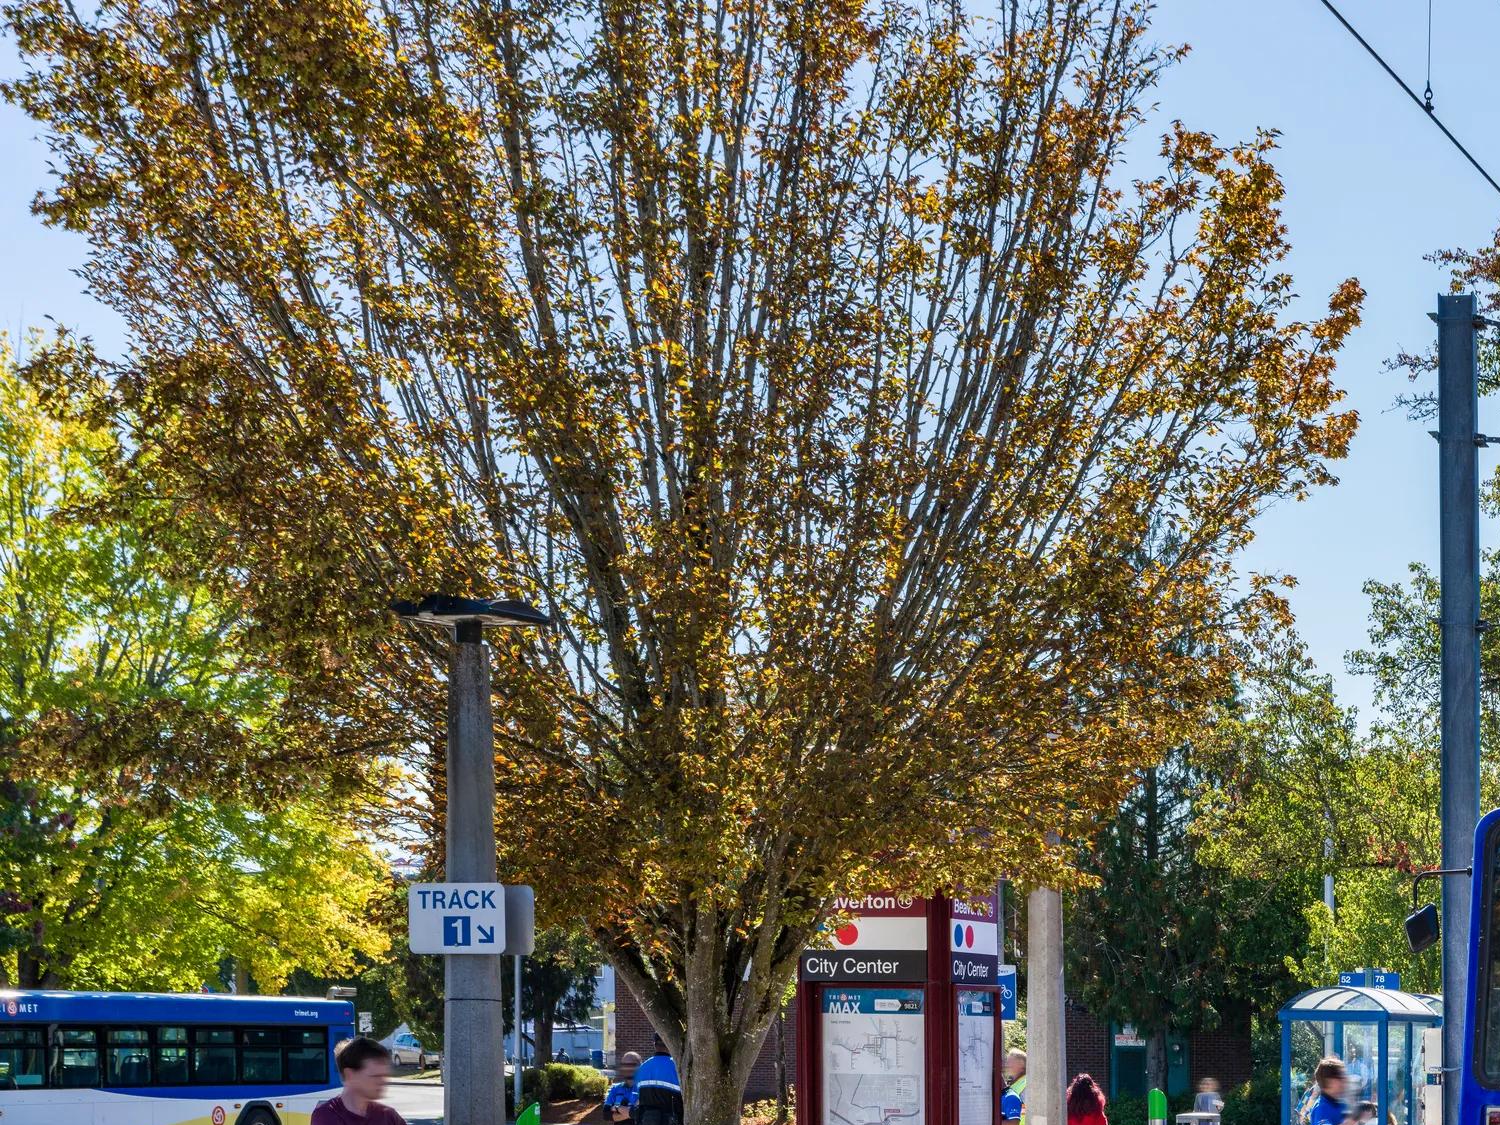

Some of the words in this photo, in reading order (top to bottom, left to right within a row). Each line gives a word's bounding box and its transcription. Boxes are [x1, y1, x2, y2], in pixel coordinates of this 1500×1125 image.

[417, 889, 497, 910] TRACK
[451, 918, 463, 944] 1
[806, 957, 838, 977] City
[843, 957, 900, 975] Center
[953, 960, 967, 980] City
[967, 961, 989, 979] Center
[1341, 975, 1351, 984] 52
[1375, 975, 1385, 983] 78
[19, 1003, 39, 1013] MET
[829, 1001, 861, 1014] MAX
